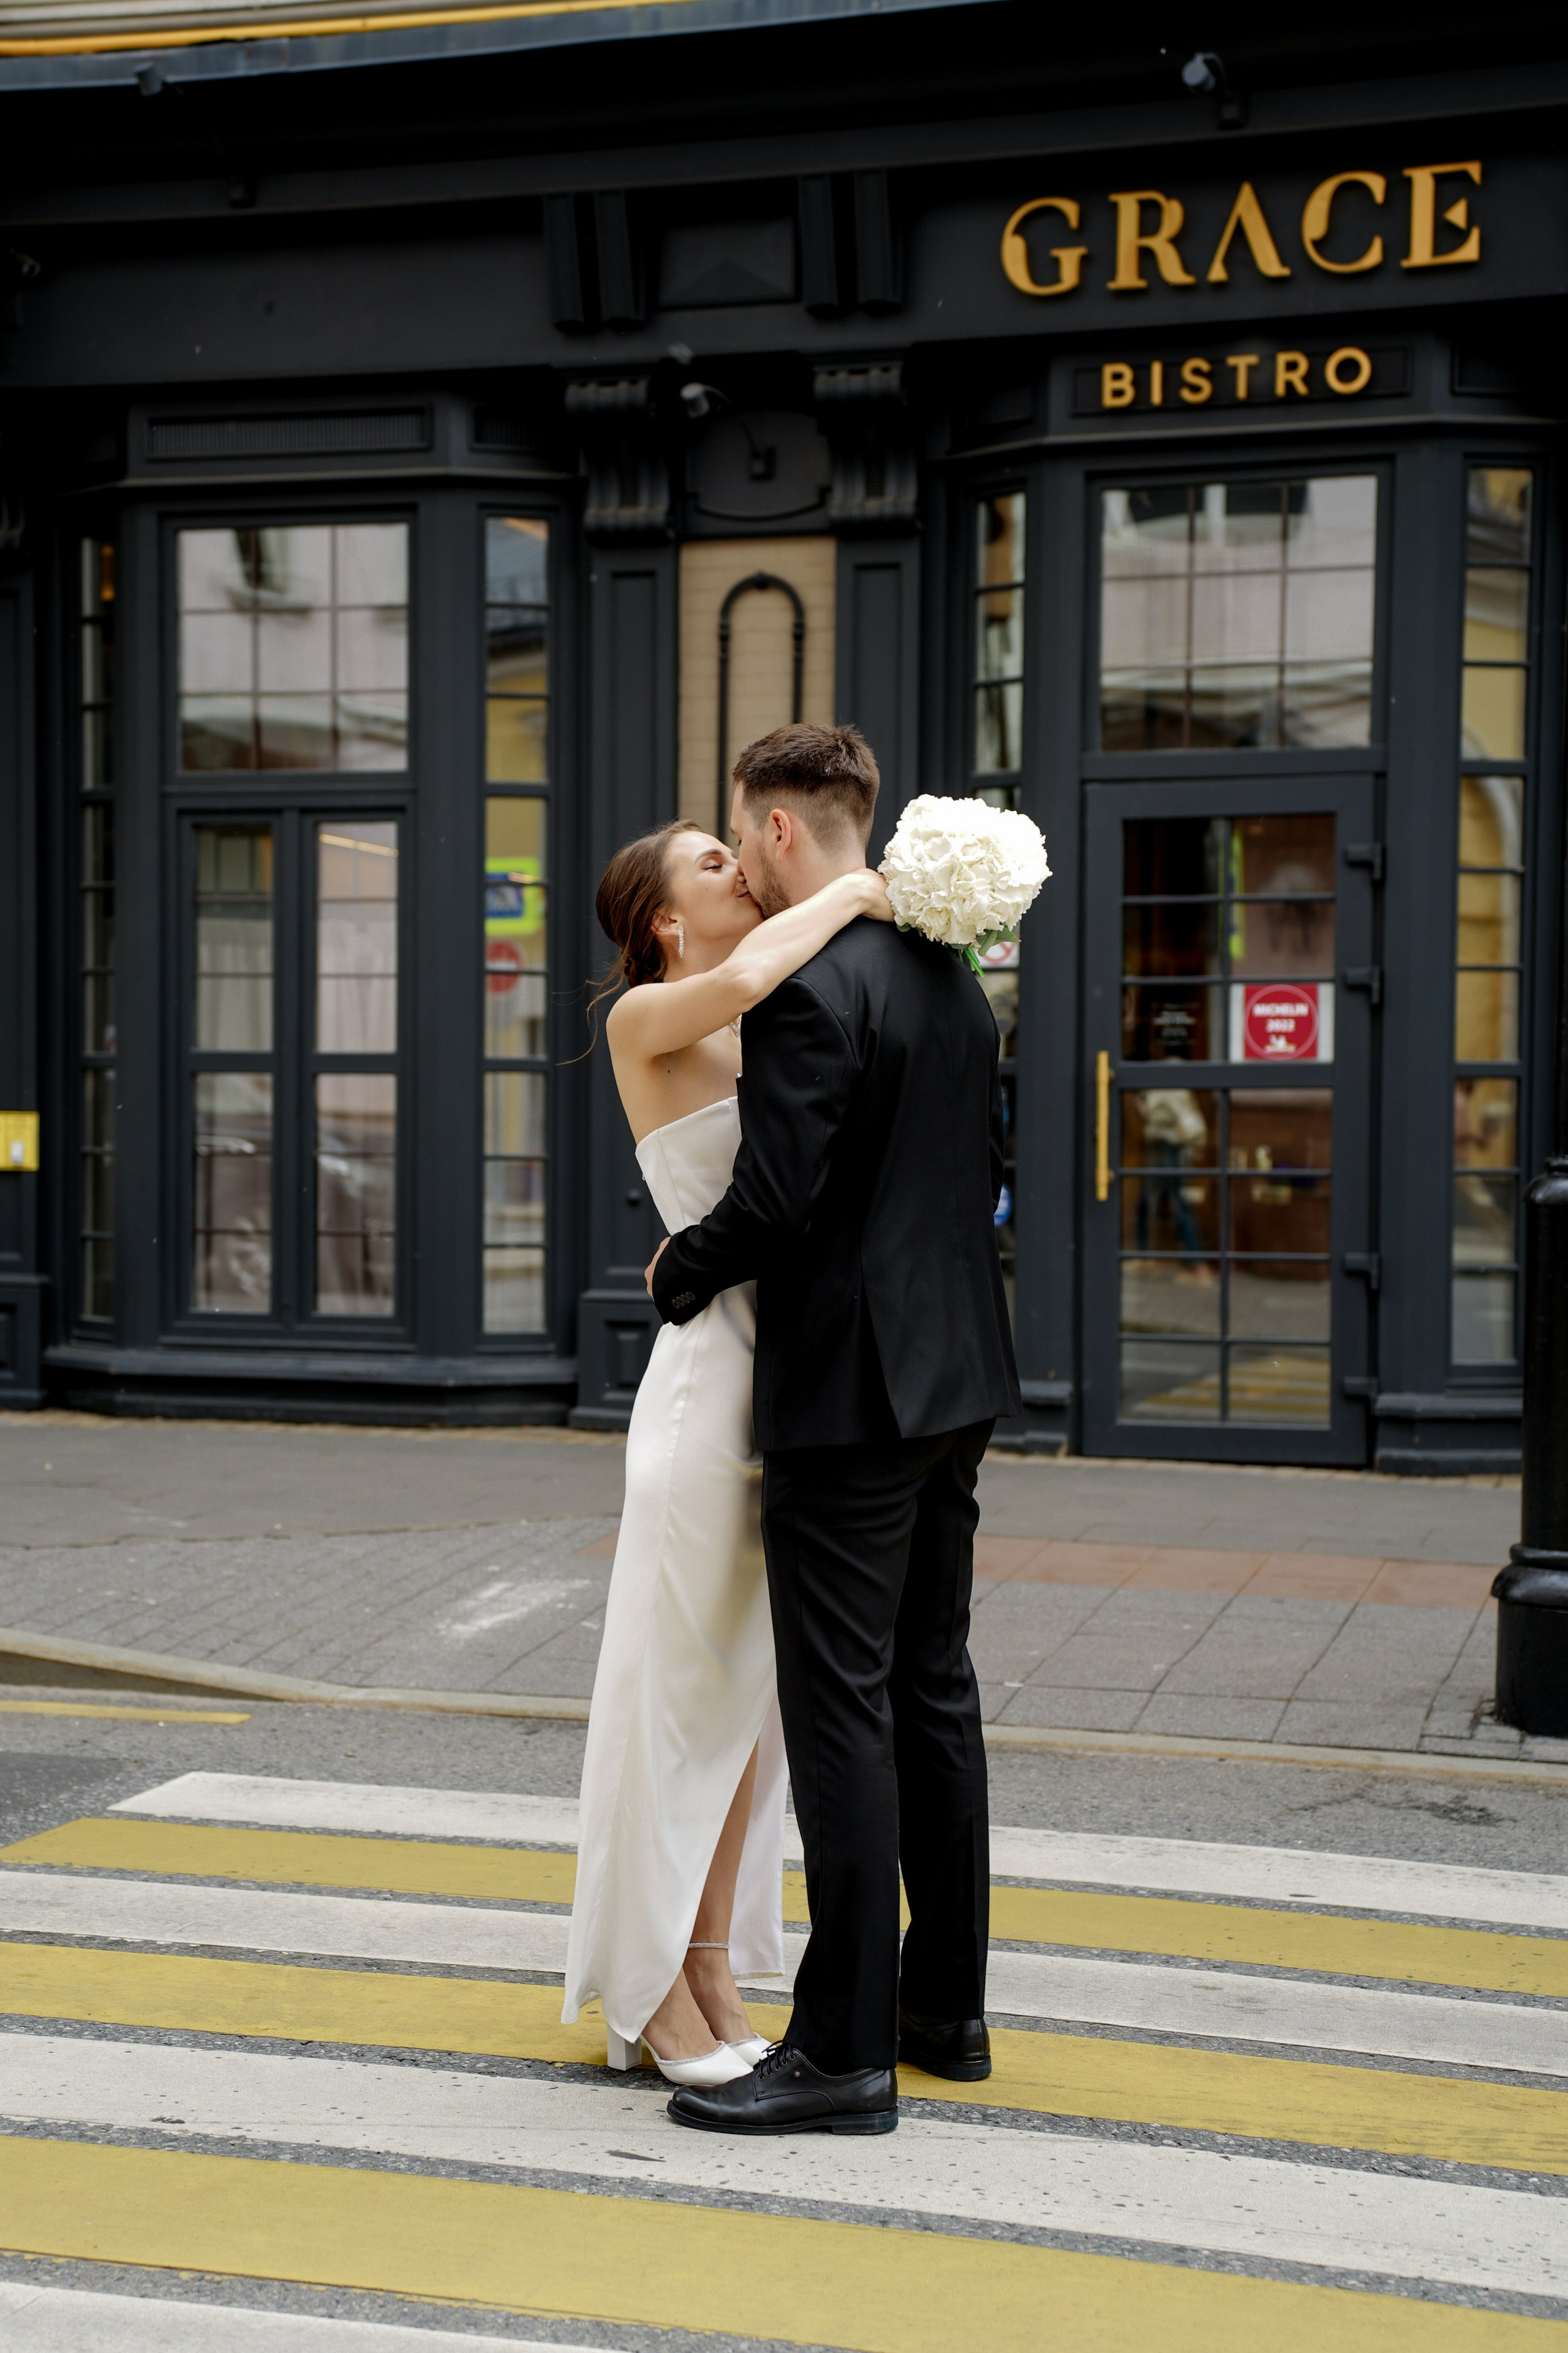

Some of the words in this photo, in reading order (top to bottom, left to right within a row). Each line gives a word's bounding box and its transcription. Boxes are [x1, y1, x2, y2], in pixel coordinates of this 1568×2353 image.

[1001, 161, 1482, 295] GRACE
[1102, 347, 1371, 408] BISTRO
[1253, 1002, 1309, 1017] MICHELIN
